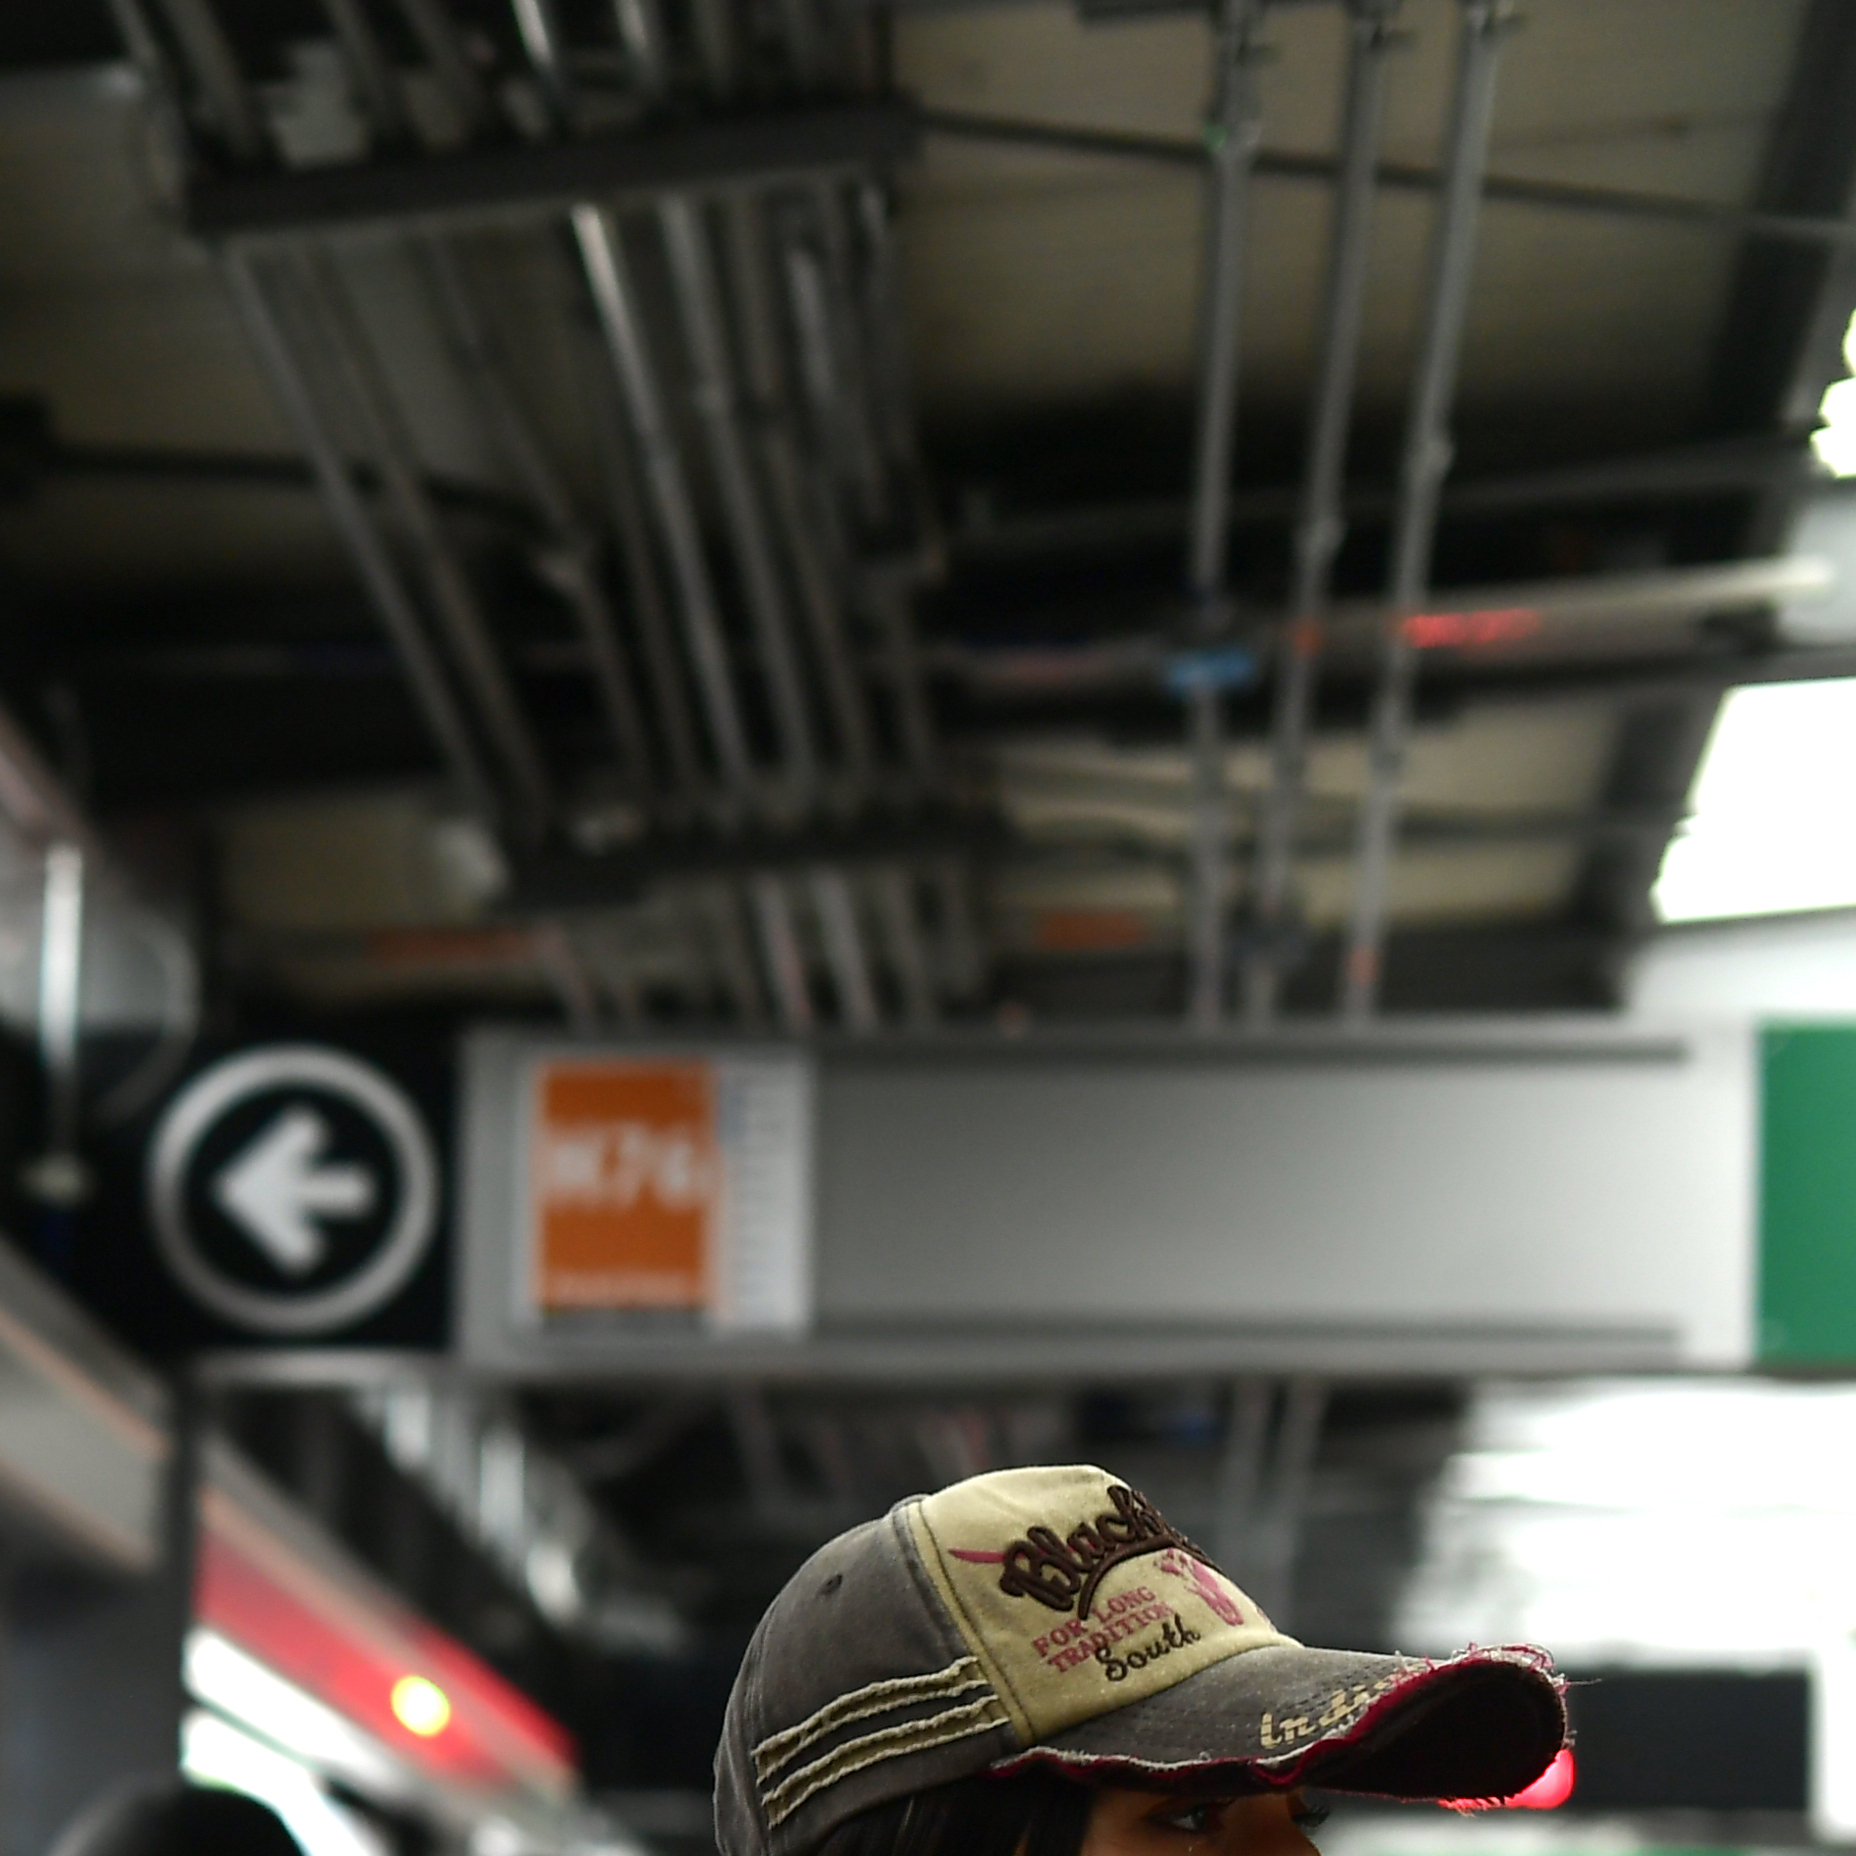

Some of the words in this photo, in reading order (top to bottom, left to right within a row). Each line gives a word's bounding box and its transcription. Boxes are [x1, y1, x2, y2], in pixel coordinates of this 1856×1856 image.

[1032, 1619, 1088, 1657] FOR
[1092, 1586, 1157, 1624] LONG
[1048, 1601, 1174, 1674] TRADITION
[1096, 1613, 1201, 1682] South
